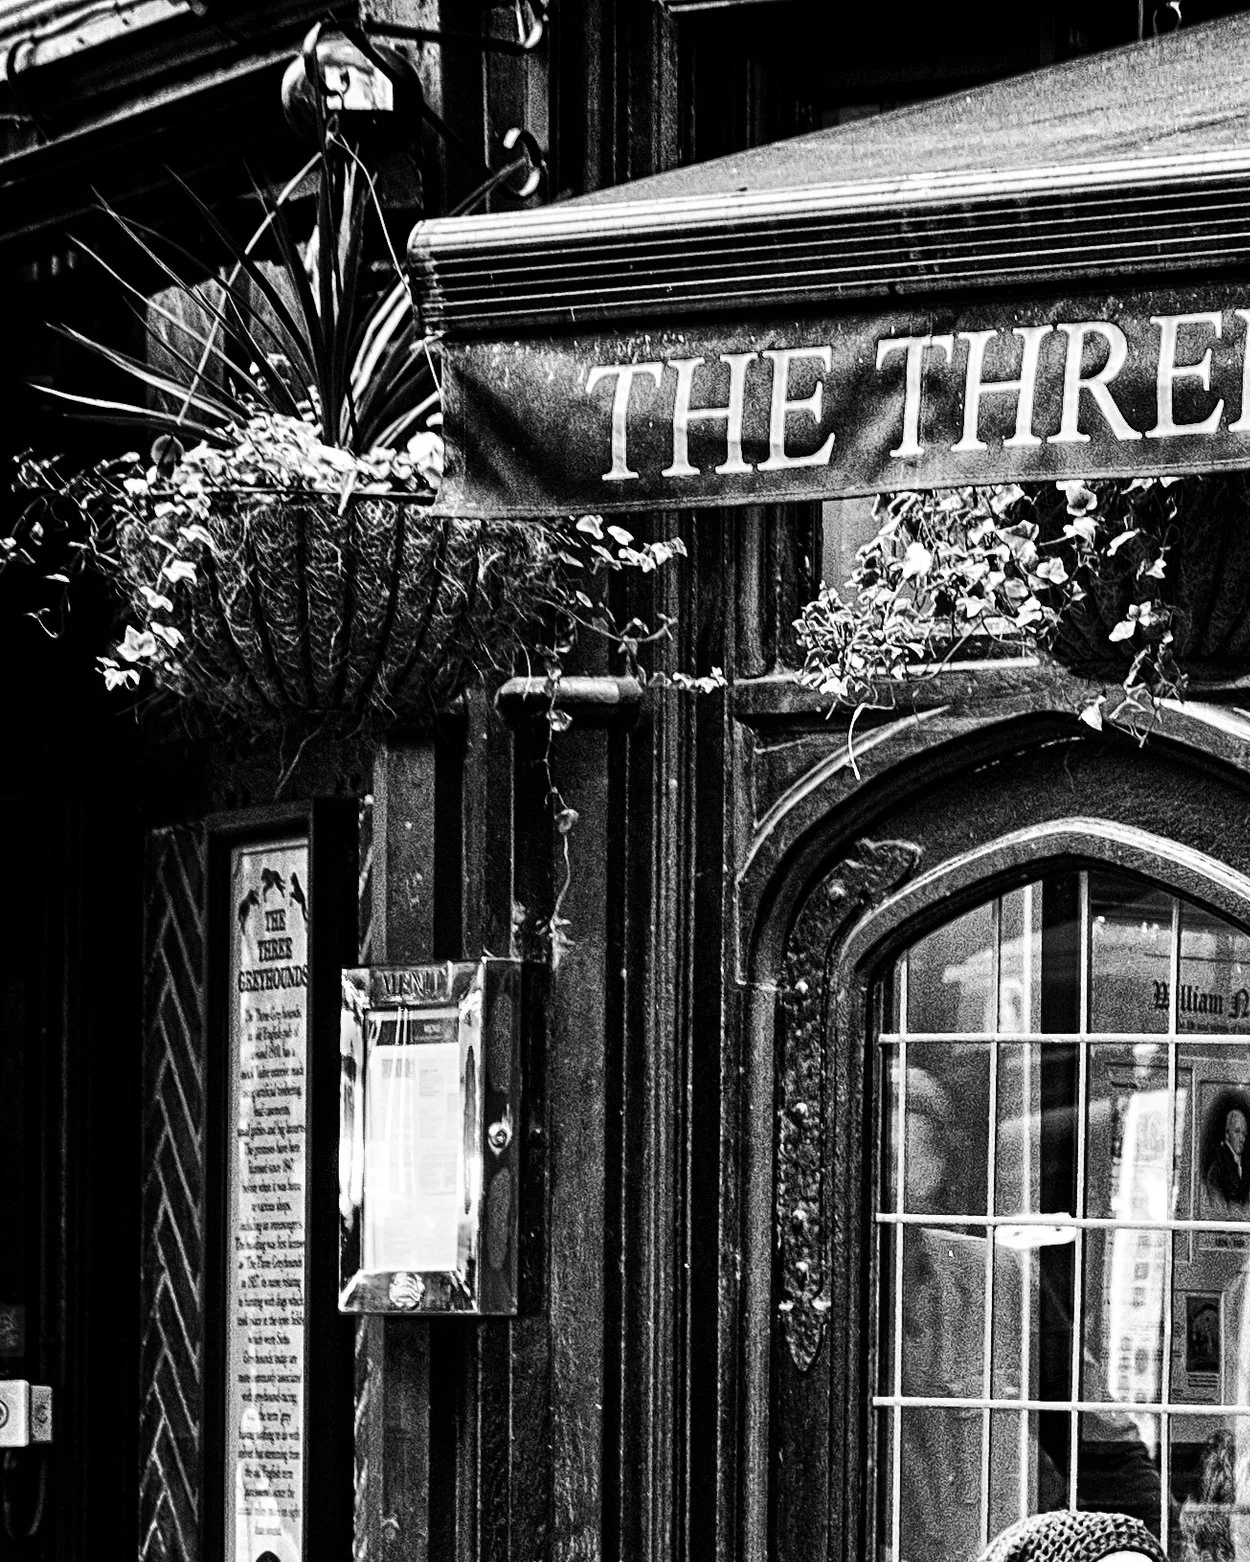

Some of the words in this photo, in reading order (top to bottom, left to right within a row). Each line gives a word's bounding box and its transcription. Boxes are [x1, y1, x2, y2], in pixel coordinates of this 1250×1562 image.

[586, 346, 836, 483] THE
[264, 908, 287, 932] THE
[257, 937, 293, 962] THREE
[238, 965, 309, 993] GREYHOUNDS
[1152, 979, 1224, 1015] Wlliam
